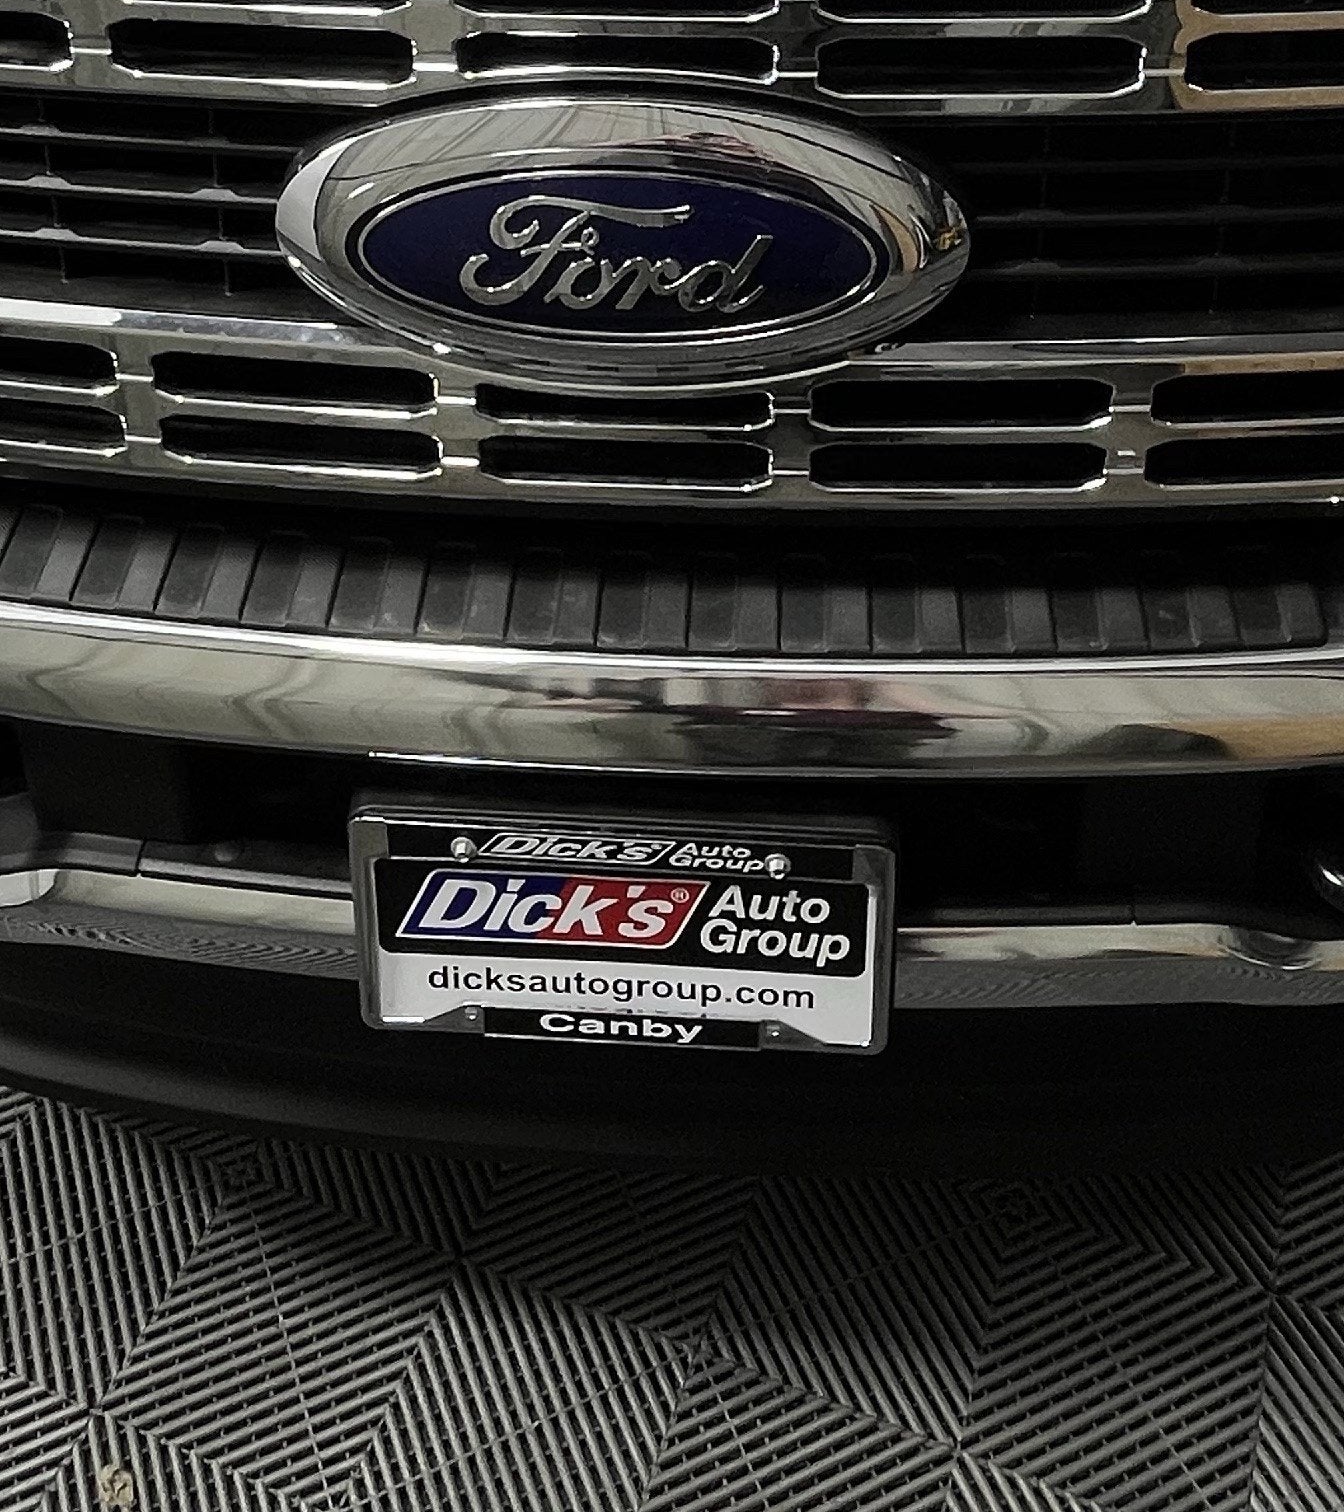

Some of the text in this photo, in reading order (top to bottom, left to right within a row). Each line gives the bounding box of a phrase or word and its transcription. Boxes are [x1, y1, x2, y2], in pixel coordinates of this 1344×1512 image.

[460, 194, 774, 314] Ford
[490, 834, 654, 862] Dick's
[668, 855, 766, 873] Group
[674, 842, 752, 858] Auto
[418, 878, 673, 938] Dick's
[708, 884, 831, 924] Auto
[700, 918, 851, 968] Group
[427, 964, 815, 1009] dicksautogroup.com
[539, 1013, 703, 1044] Canby
